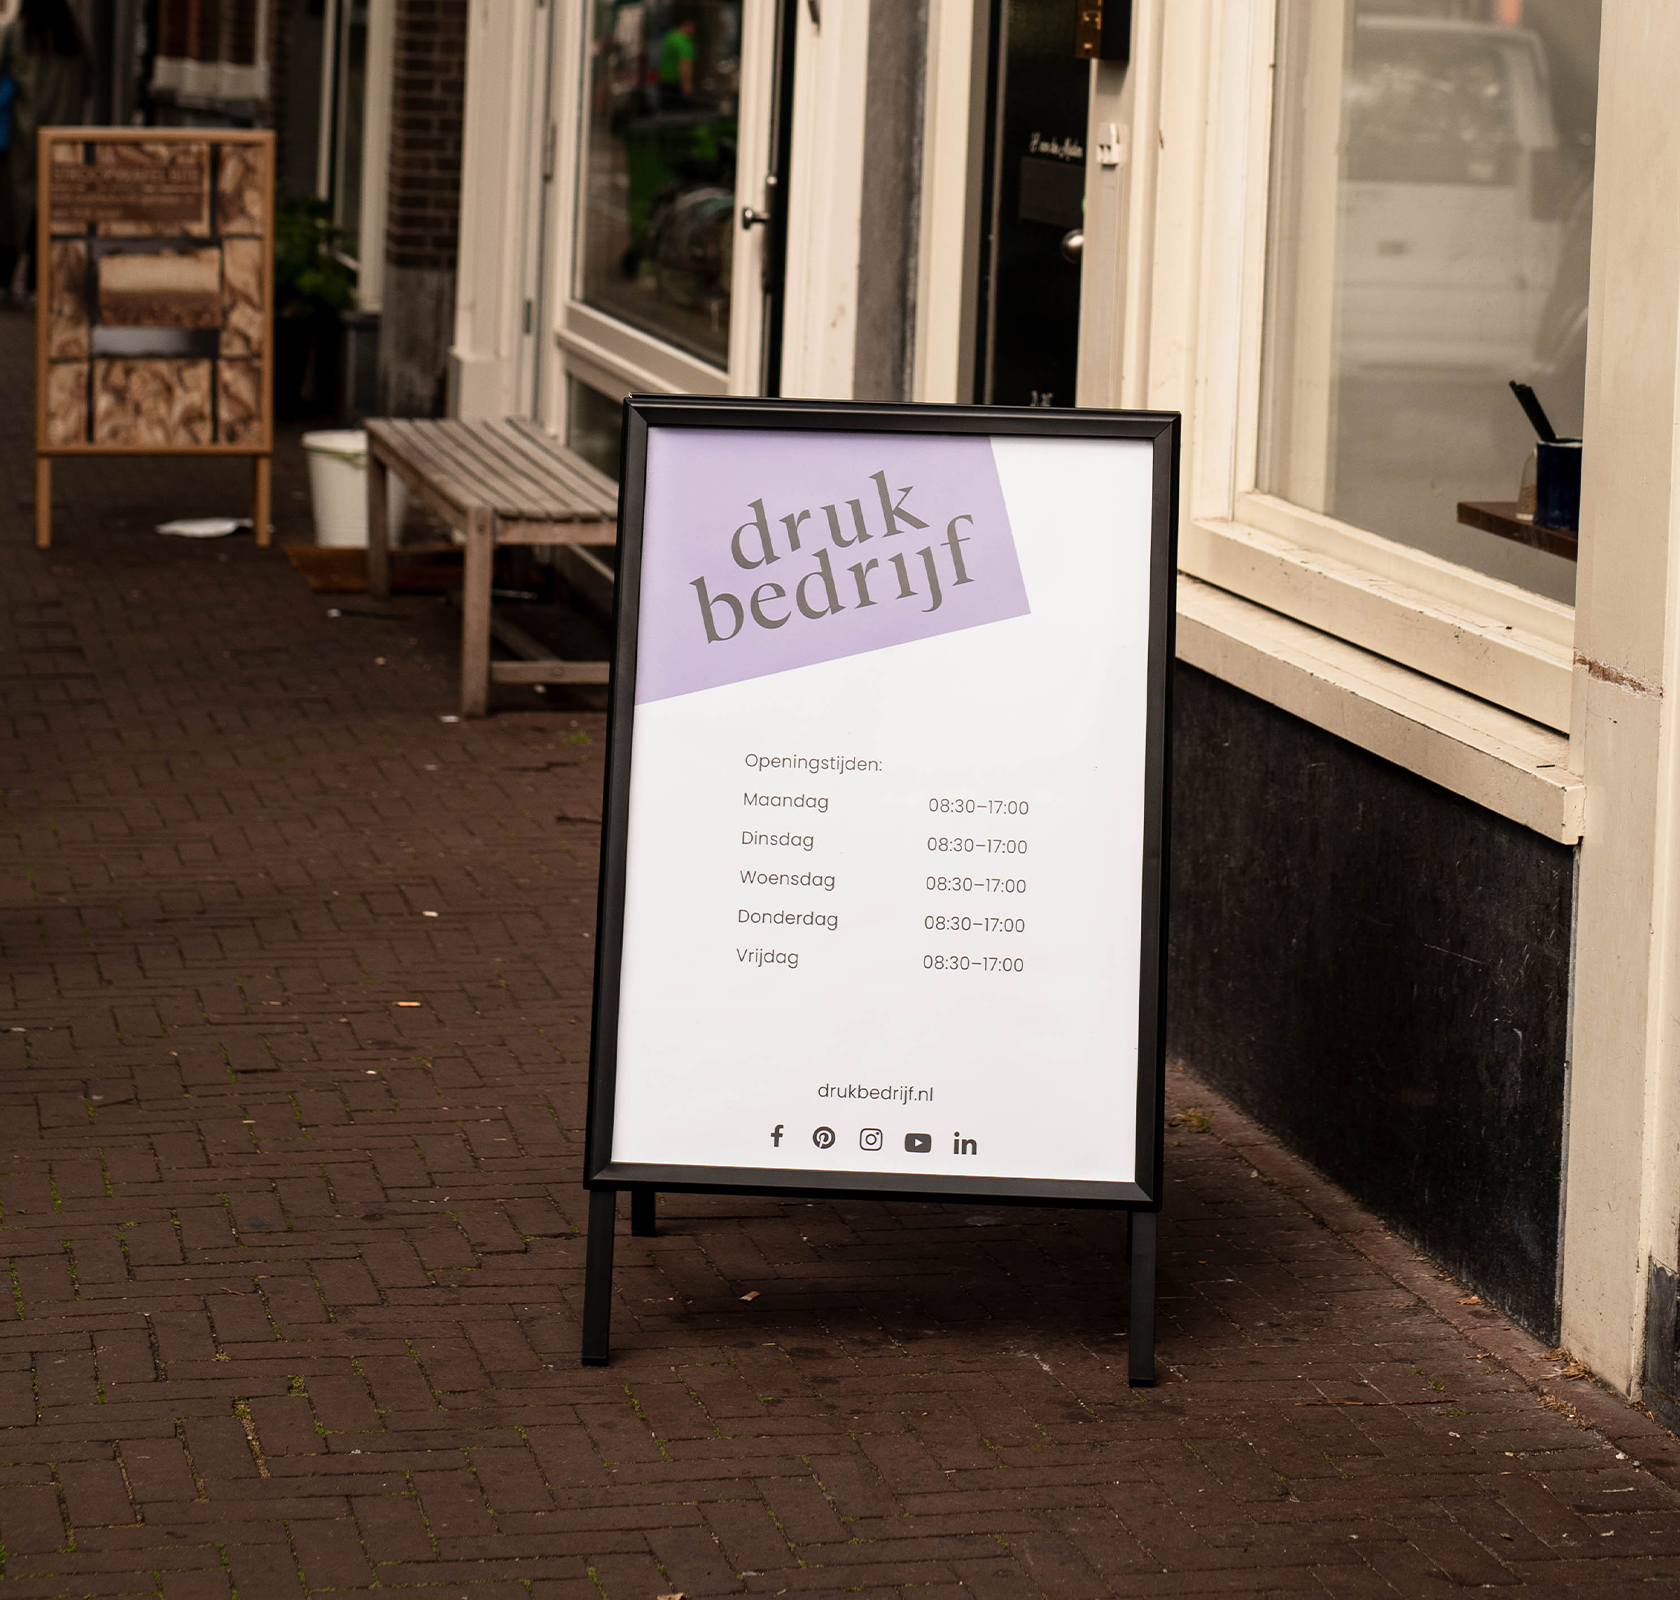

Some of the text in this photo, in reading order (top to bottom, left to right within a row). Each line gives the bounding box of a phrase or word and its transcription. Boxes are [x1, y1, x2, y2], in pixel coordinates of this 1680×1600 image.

[731, 470, 930, 569] druk
[689, 514, 975, 644] bedrijf
[744, 753, 883, 775] Openingstijden:
[743, 792, 829, 814] Maandag
[741, 830, 814, 852] Dinsdag
[739, 869, 836, 892] Woensdag
[737, 908, 839, 932] Donderdag
[735, 947, 799, 970] Vrijdag
[817, 1082, 934, 1106] drukbedrijf.nl
